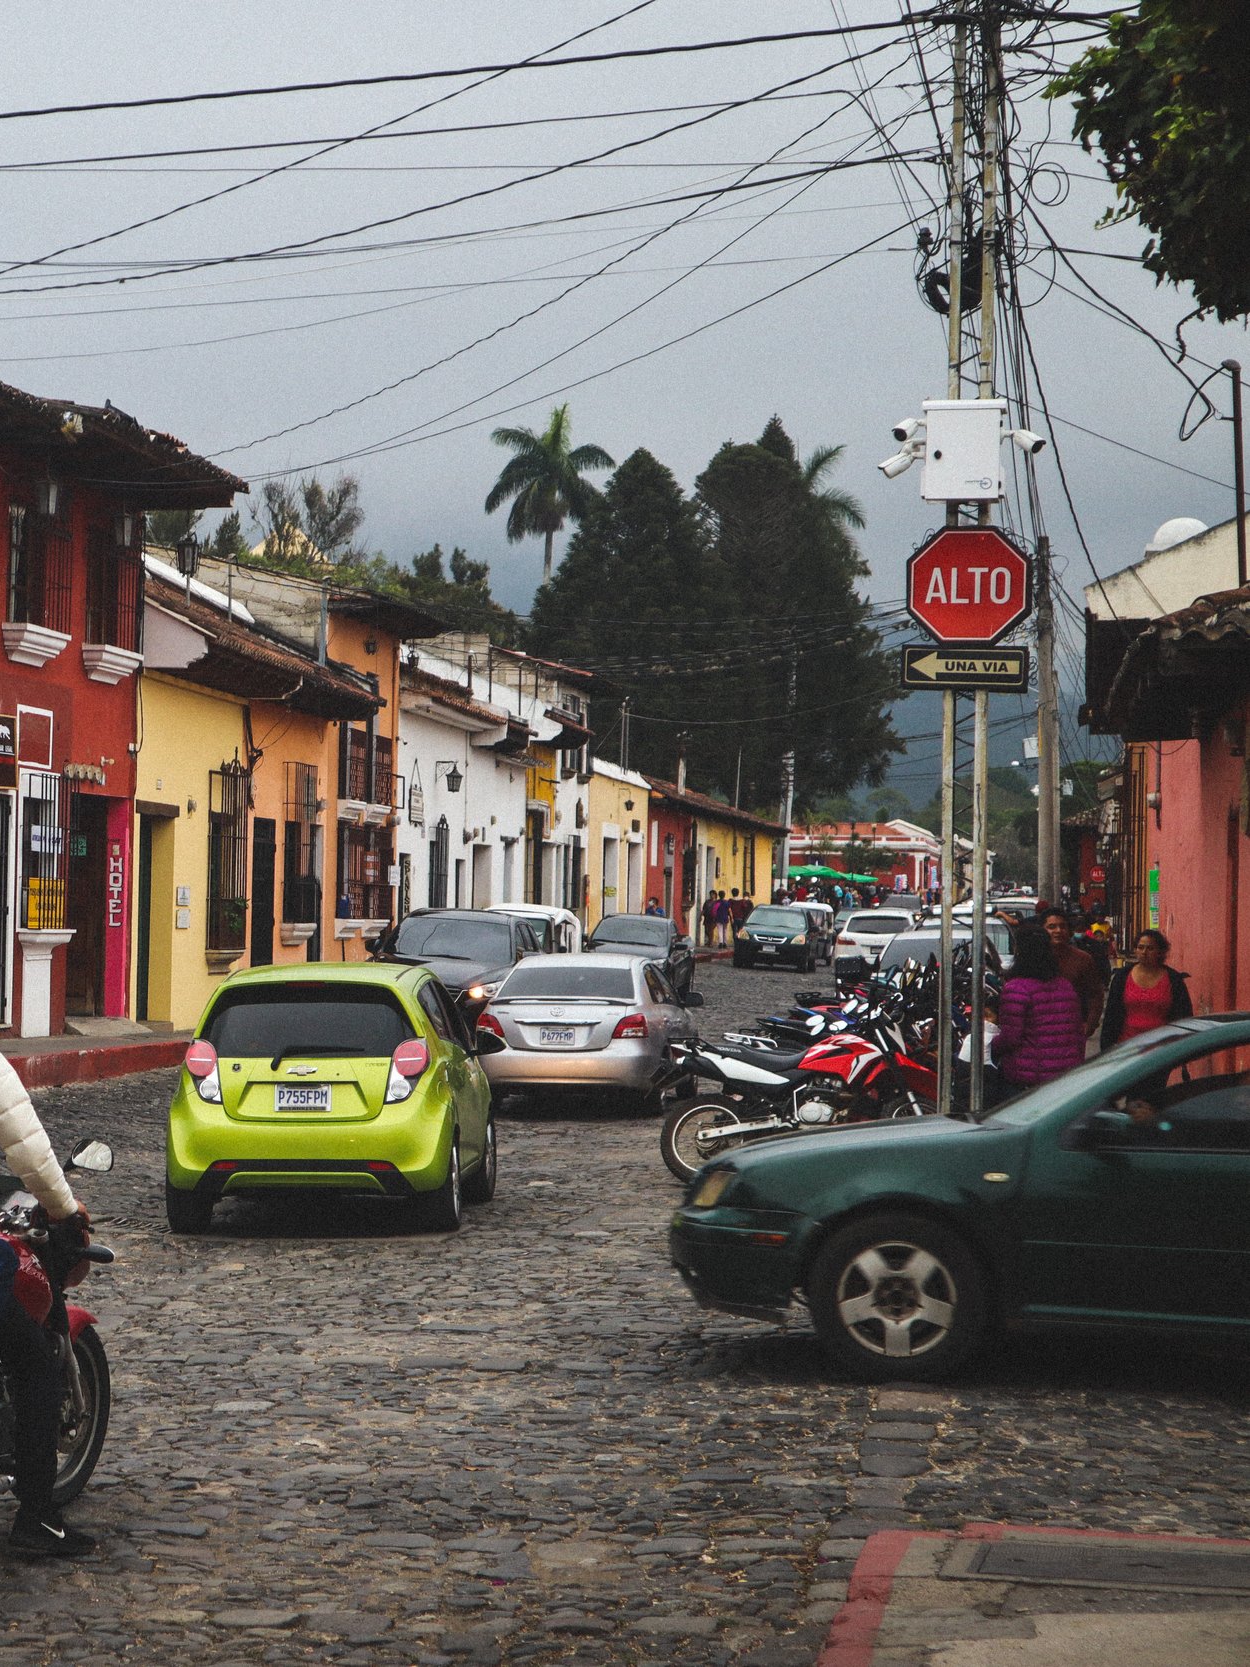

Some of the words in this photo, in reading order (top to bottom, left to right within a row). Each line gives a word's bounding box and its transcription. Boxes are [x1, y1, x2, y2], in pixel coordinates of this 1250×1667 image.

[925, 566, 1012, 605] ALTO
[944, 660, 978, 672] UNA
[982, 661, 1009, 673] VIA
[109, 857, 123, 926] HOTEL
[278, 1089, 328, 1104] P755FPM
